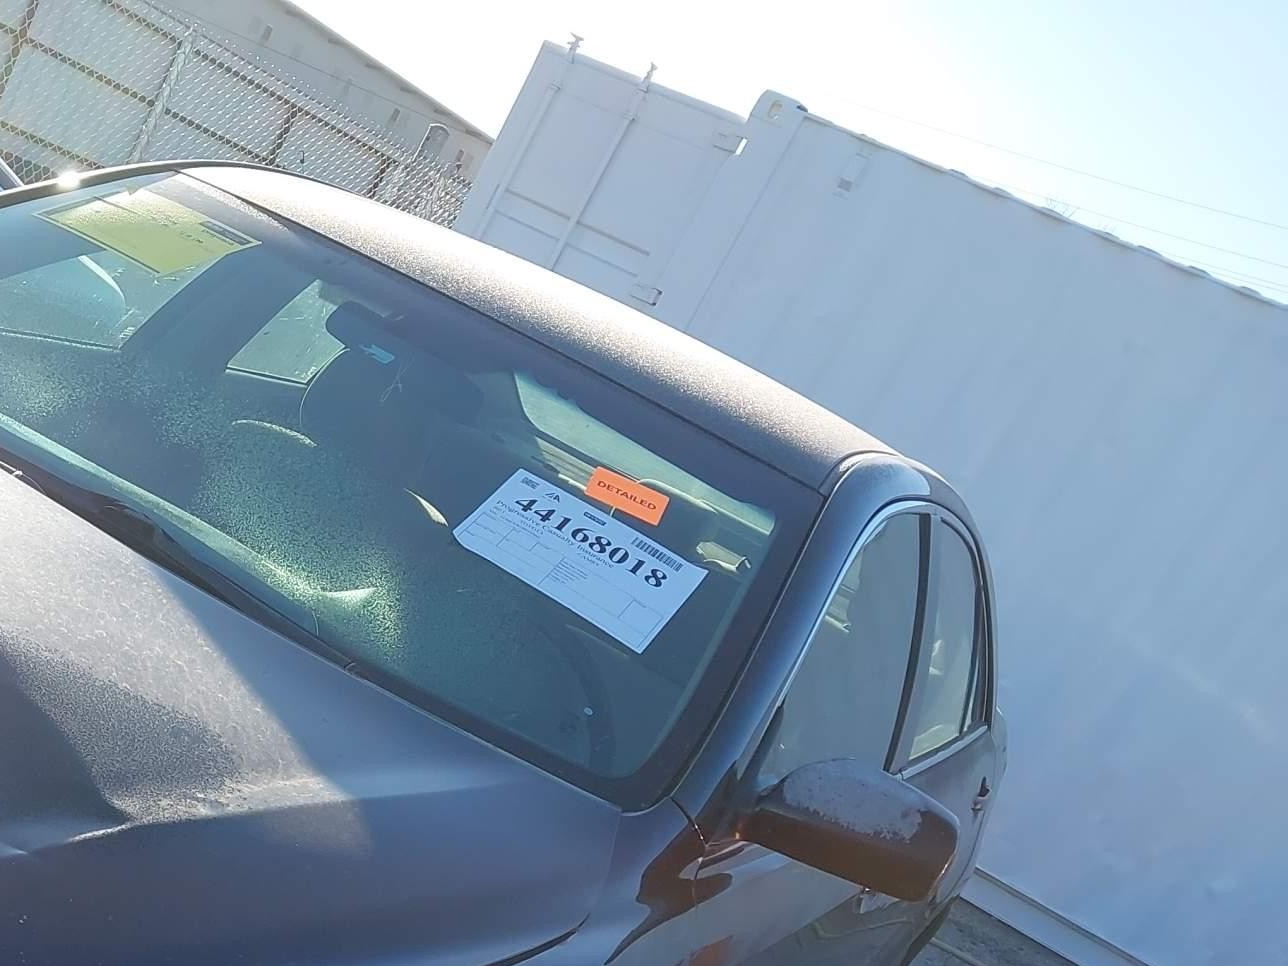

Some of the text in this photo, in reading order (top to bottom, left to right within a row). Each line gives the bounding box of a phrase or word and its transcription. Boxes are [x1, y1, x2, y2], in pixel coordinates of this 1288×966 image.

[596, 480, 657, 511] DETAILED
[514, 498, 668, 588] 44168018
[577, 544, 615, 569] Insurance
